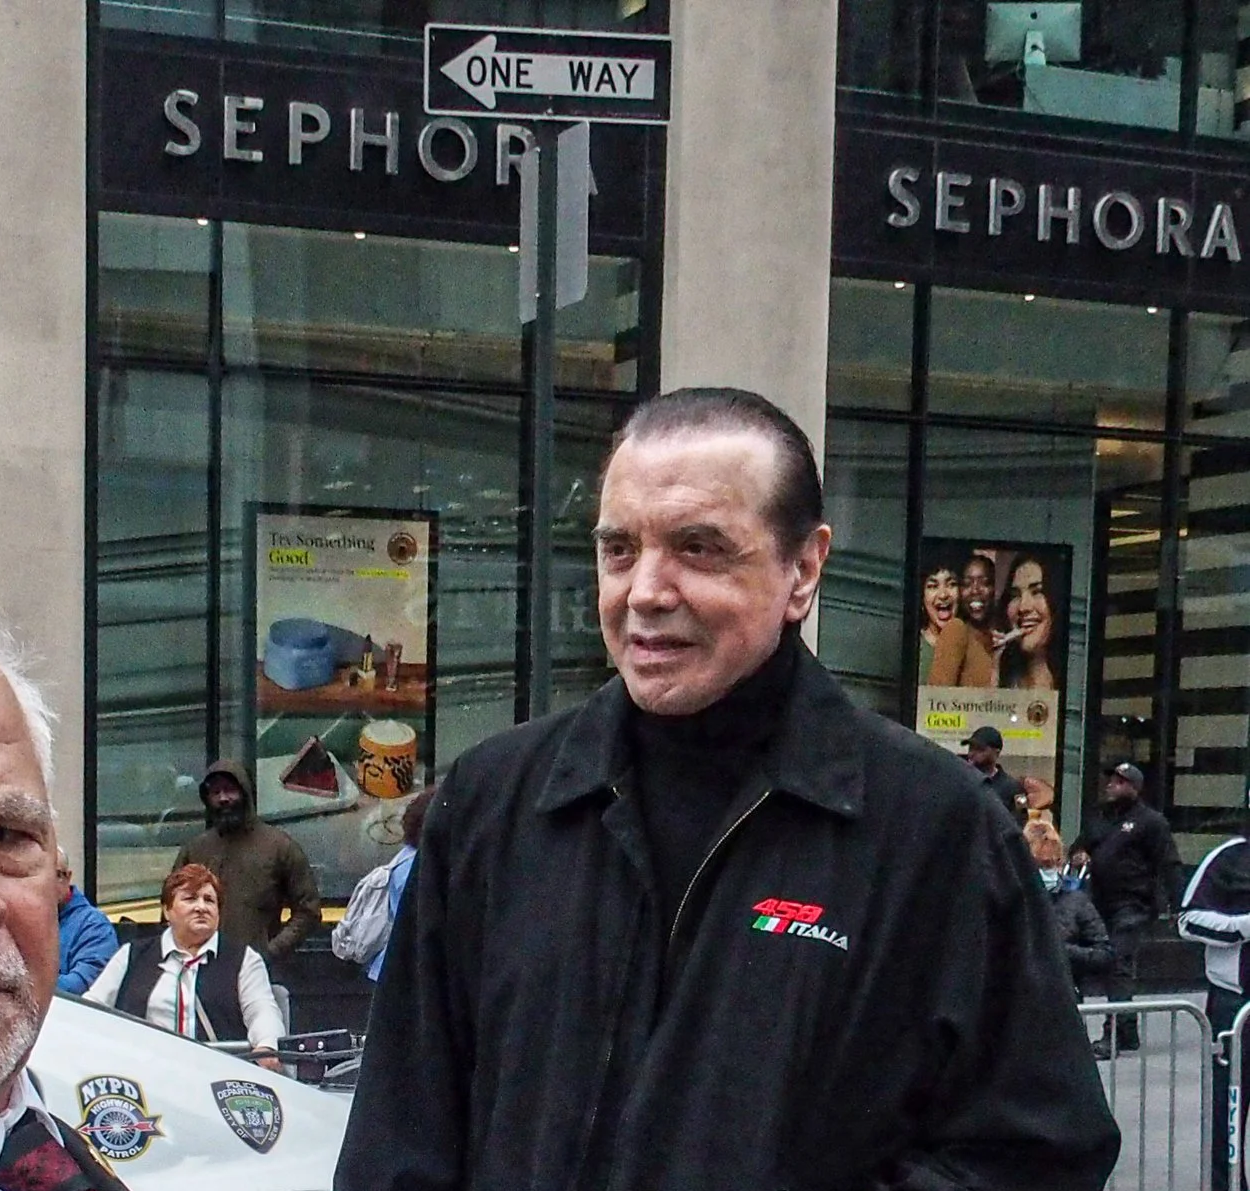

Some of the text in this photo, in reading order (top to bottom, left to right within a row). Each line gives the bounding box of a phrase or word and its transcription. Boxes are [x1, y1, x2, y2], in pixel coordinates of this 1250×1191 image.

[467, 55, 640, 95] ONE WAY
[163, 89, 599, 195] SEPHOR
[886, 165, 1242, 263] SEPHORA
[269, 531, 376, 551] Try Something
[268, 550, 310, 565] Good
[929, 698, 1017, 715] Try Something
[927, 714, 961, 728] Good
[752, 898, 824, 924] 458
[787, 921, 849, 951] ITALIA
[81, 1077, 139, 1105] NYPD
[217, 1088, 274, 1102] DEPARTMENT
[225, 1081, 258, 1091] POLICE
[90, 1099, 137, 1115] HIGHWAY
[222, 1107, 249, 1140] CITY OF
[99, 1146, 143, 1158] PATROL
